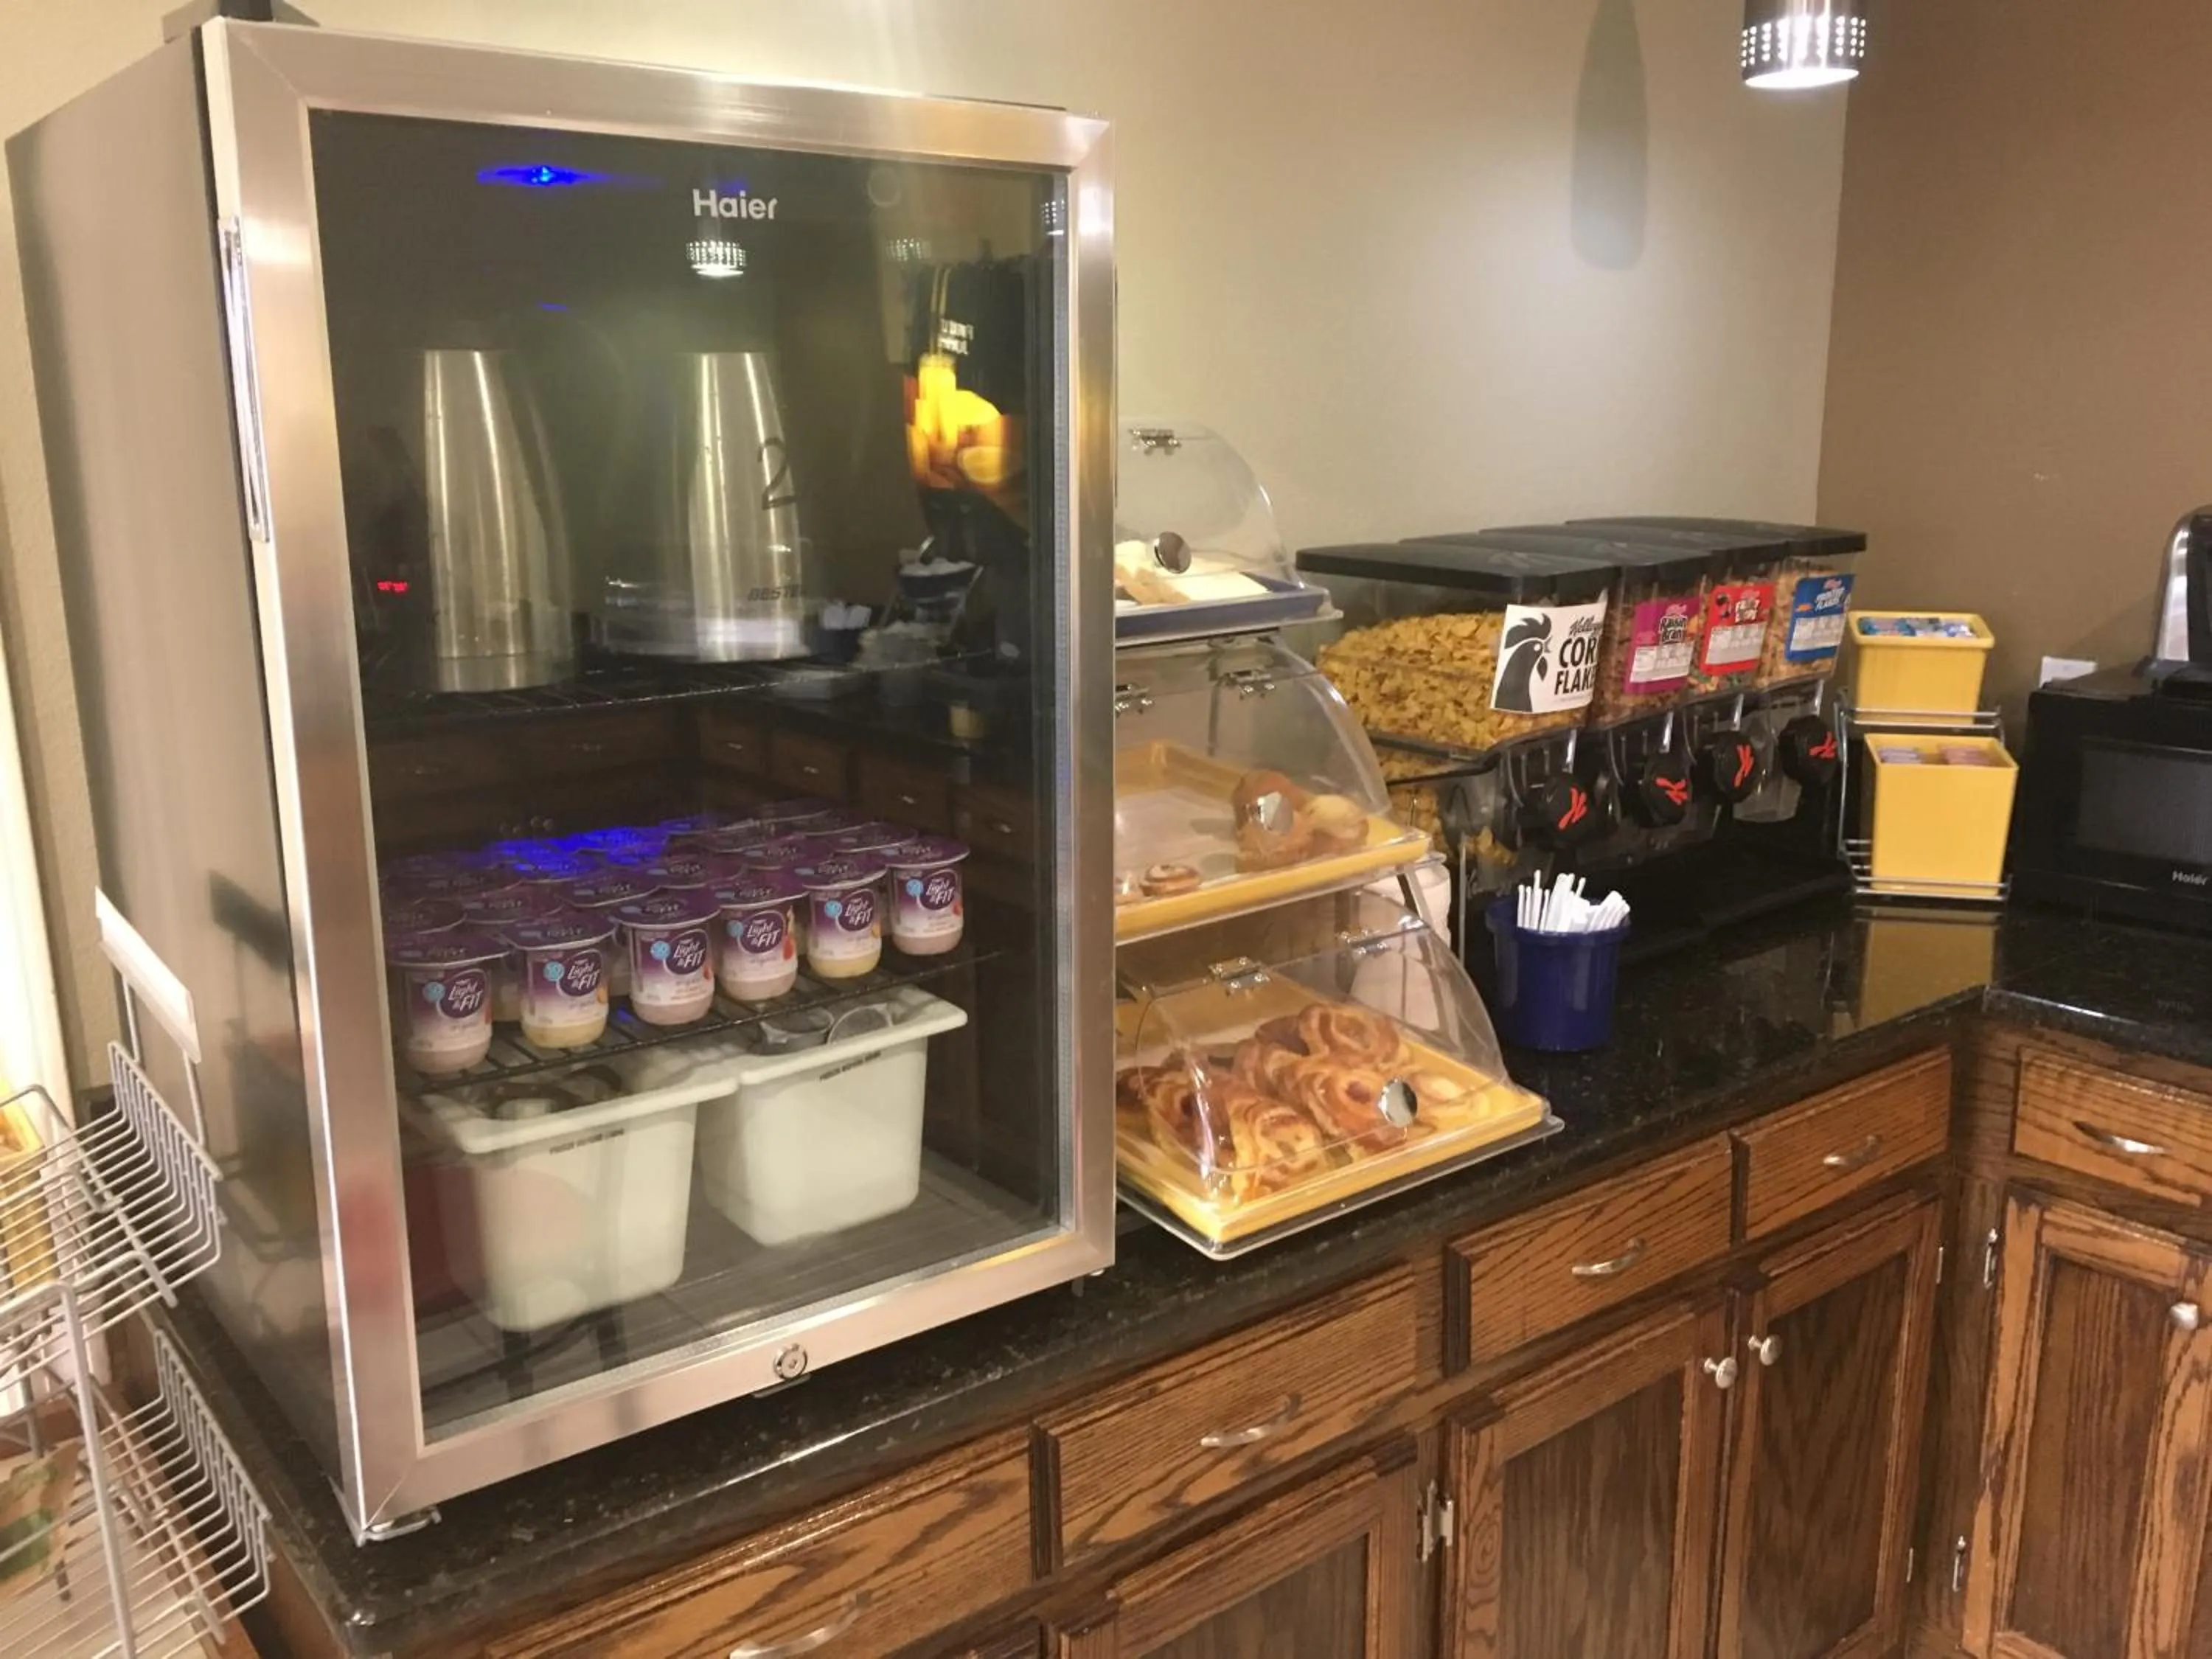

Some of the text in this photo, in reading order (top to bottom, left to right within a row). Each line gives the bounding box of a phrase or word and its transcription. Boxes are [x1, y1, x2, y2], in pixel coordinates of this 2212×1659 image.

[692, 188, 778, 220] Haier
[758, 437, 798, 511] 2
[1559, 636, 1597, 668] COR
